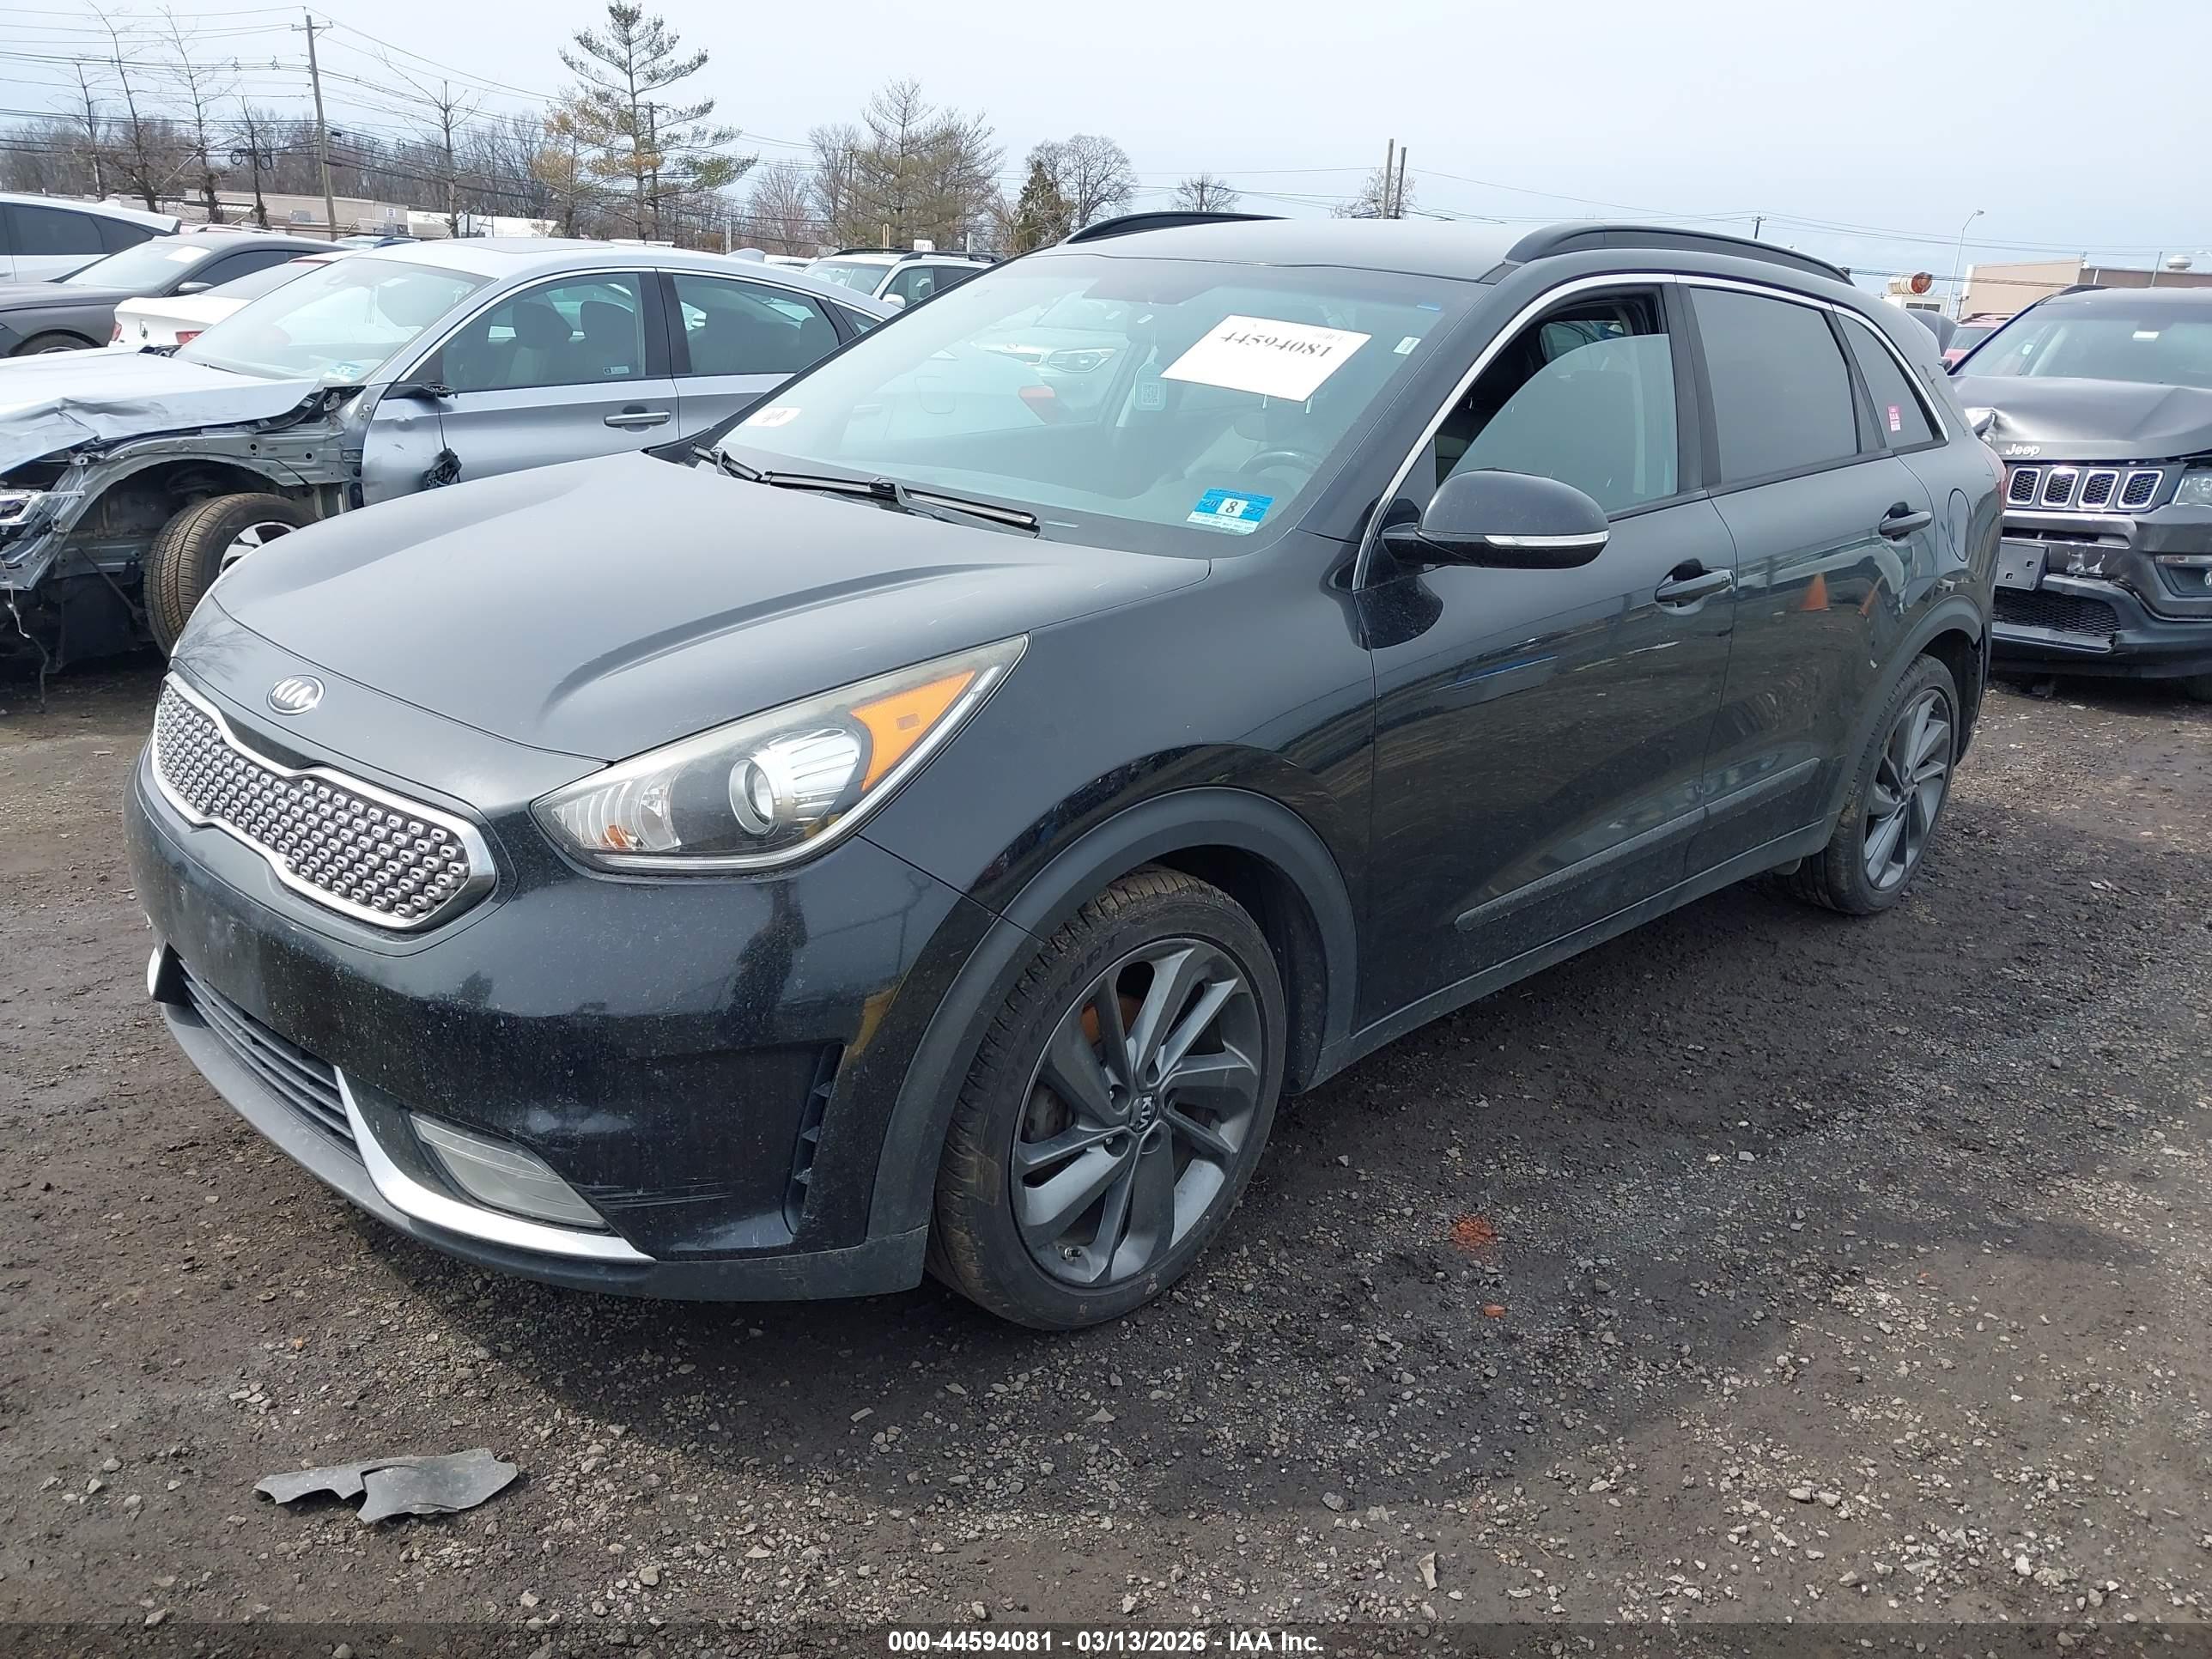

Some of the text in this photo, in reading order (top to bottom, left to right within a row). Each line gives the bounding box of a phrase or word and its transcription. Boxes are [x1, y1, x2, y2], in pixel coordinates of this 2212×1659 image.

[1220, 331, 1333, 357] 44594081
[2006, 443, 2041, 458] Jeep
[1225, 501, 1238, 514] 8
[1139, 1096, 1152, 1130] KIA
